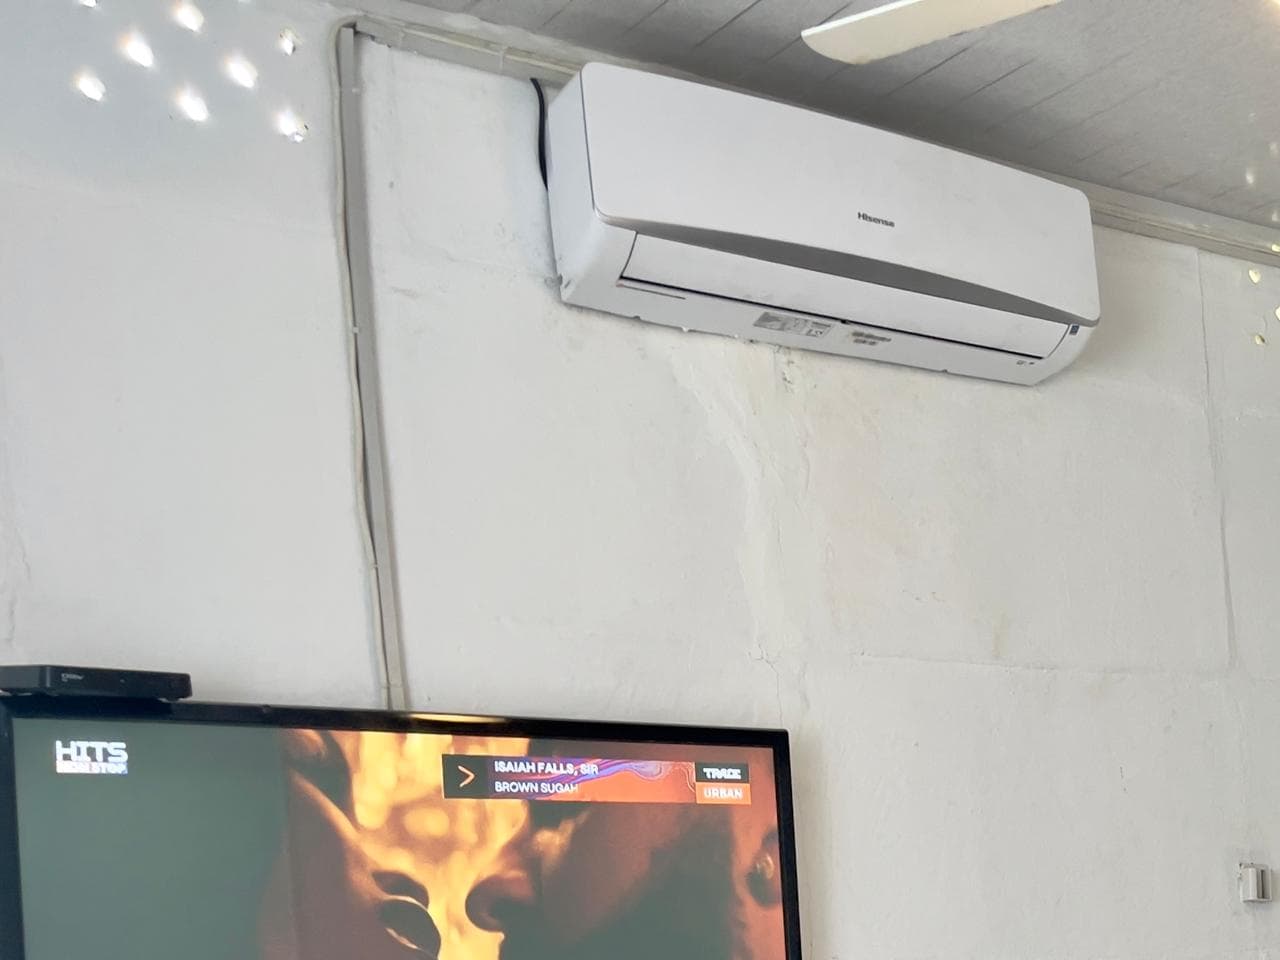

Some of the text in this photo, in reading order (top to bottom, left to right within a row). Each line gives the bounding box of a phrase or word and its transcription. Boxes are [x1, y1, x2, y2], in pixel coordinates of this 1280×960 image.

[857, 211, 895, 228] Hisense
[55, 740, 129, 763] HITS
[494, 760, 599, 776] ISAIAH FALLS, SIR
[703, 768, 742, 780] TRACE
[494, 781, 539, 793] BROWN
[703, 787, 743, 800] URBAN
